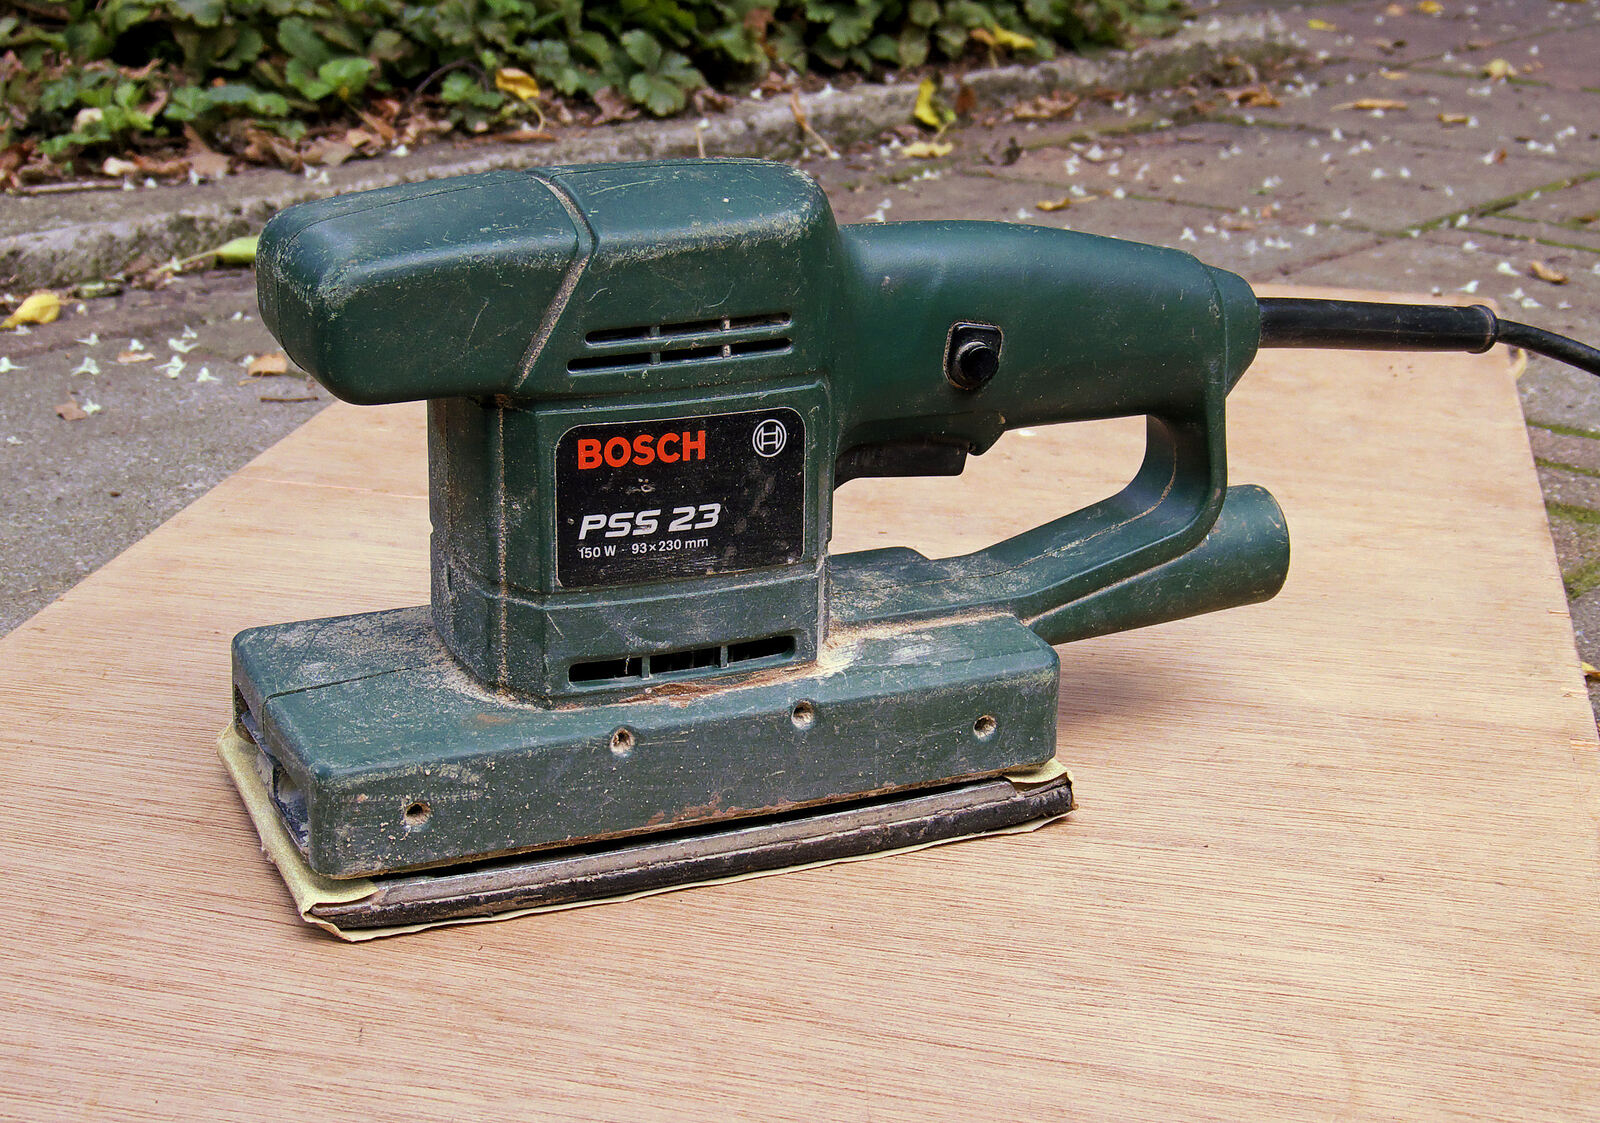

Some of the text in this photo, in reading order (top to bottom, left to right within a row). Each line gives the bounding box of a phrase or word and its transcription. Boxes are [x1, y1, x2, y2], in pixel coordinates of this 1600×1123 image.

[577, 430, 706, 470] BOSCH
[578, 503, 722, 540] PSS 23
[578, 546, 601, 559] 150
[604, 545, 617, 557] W
[685, 538, 709, 549] mm
